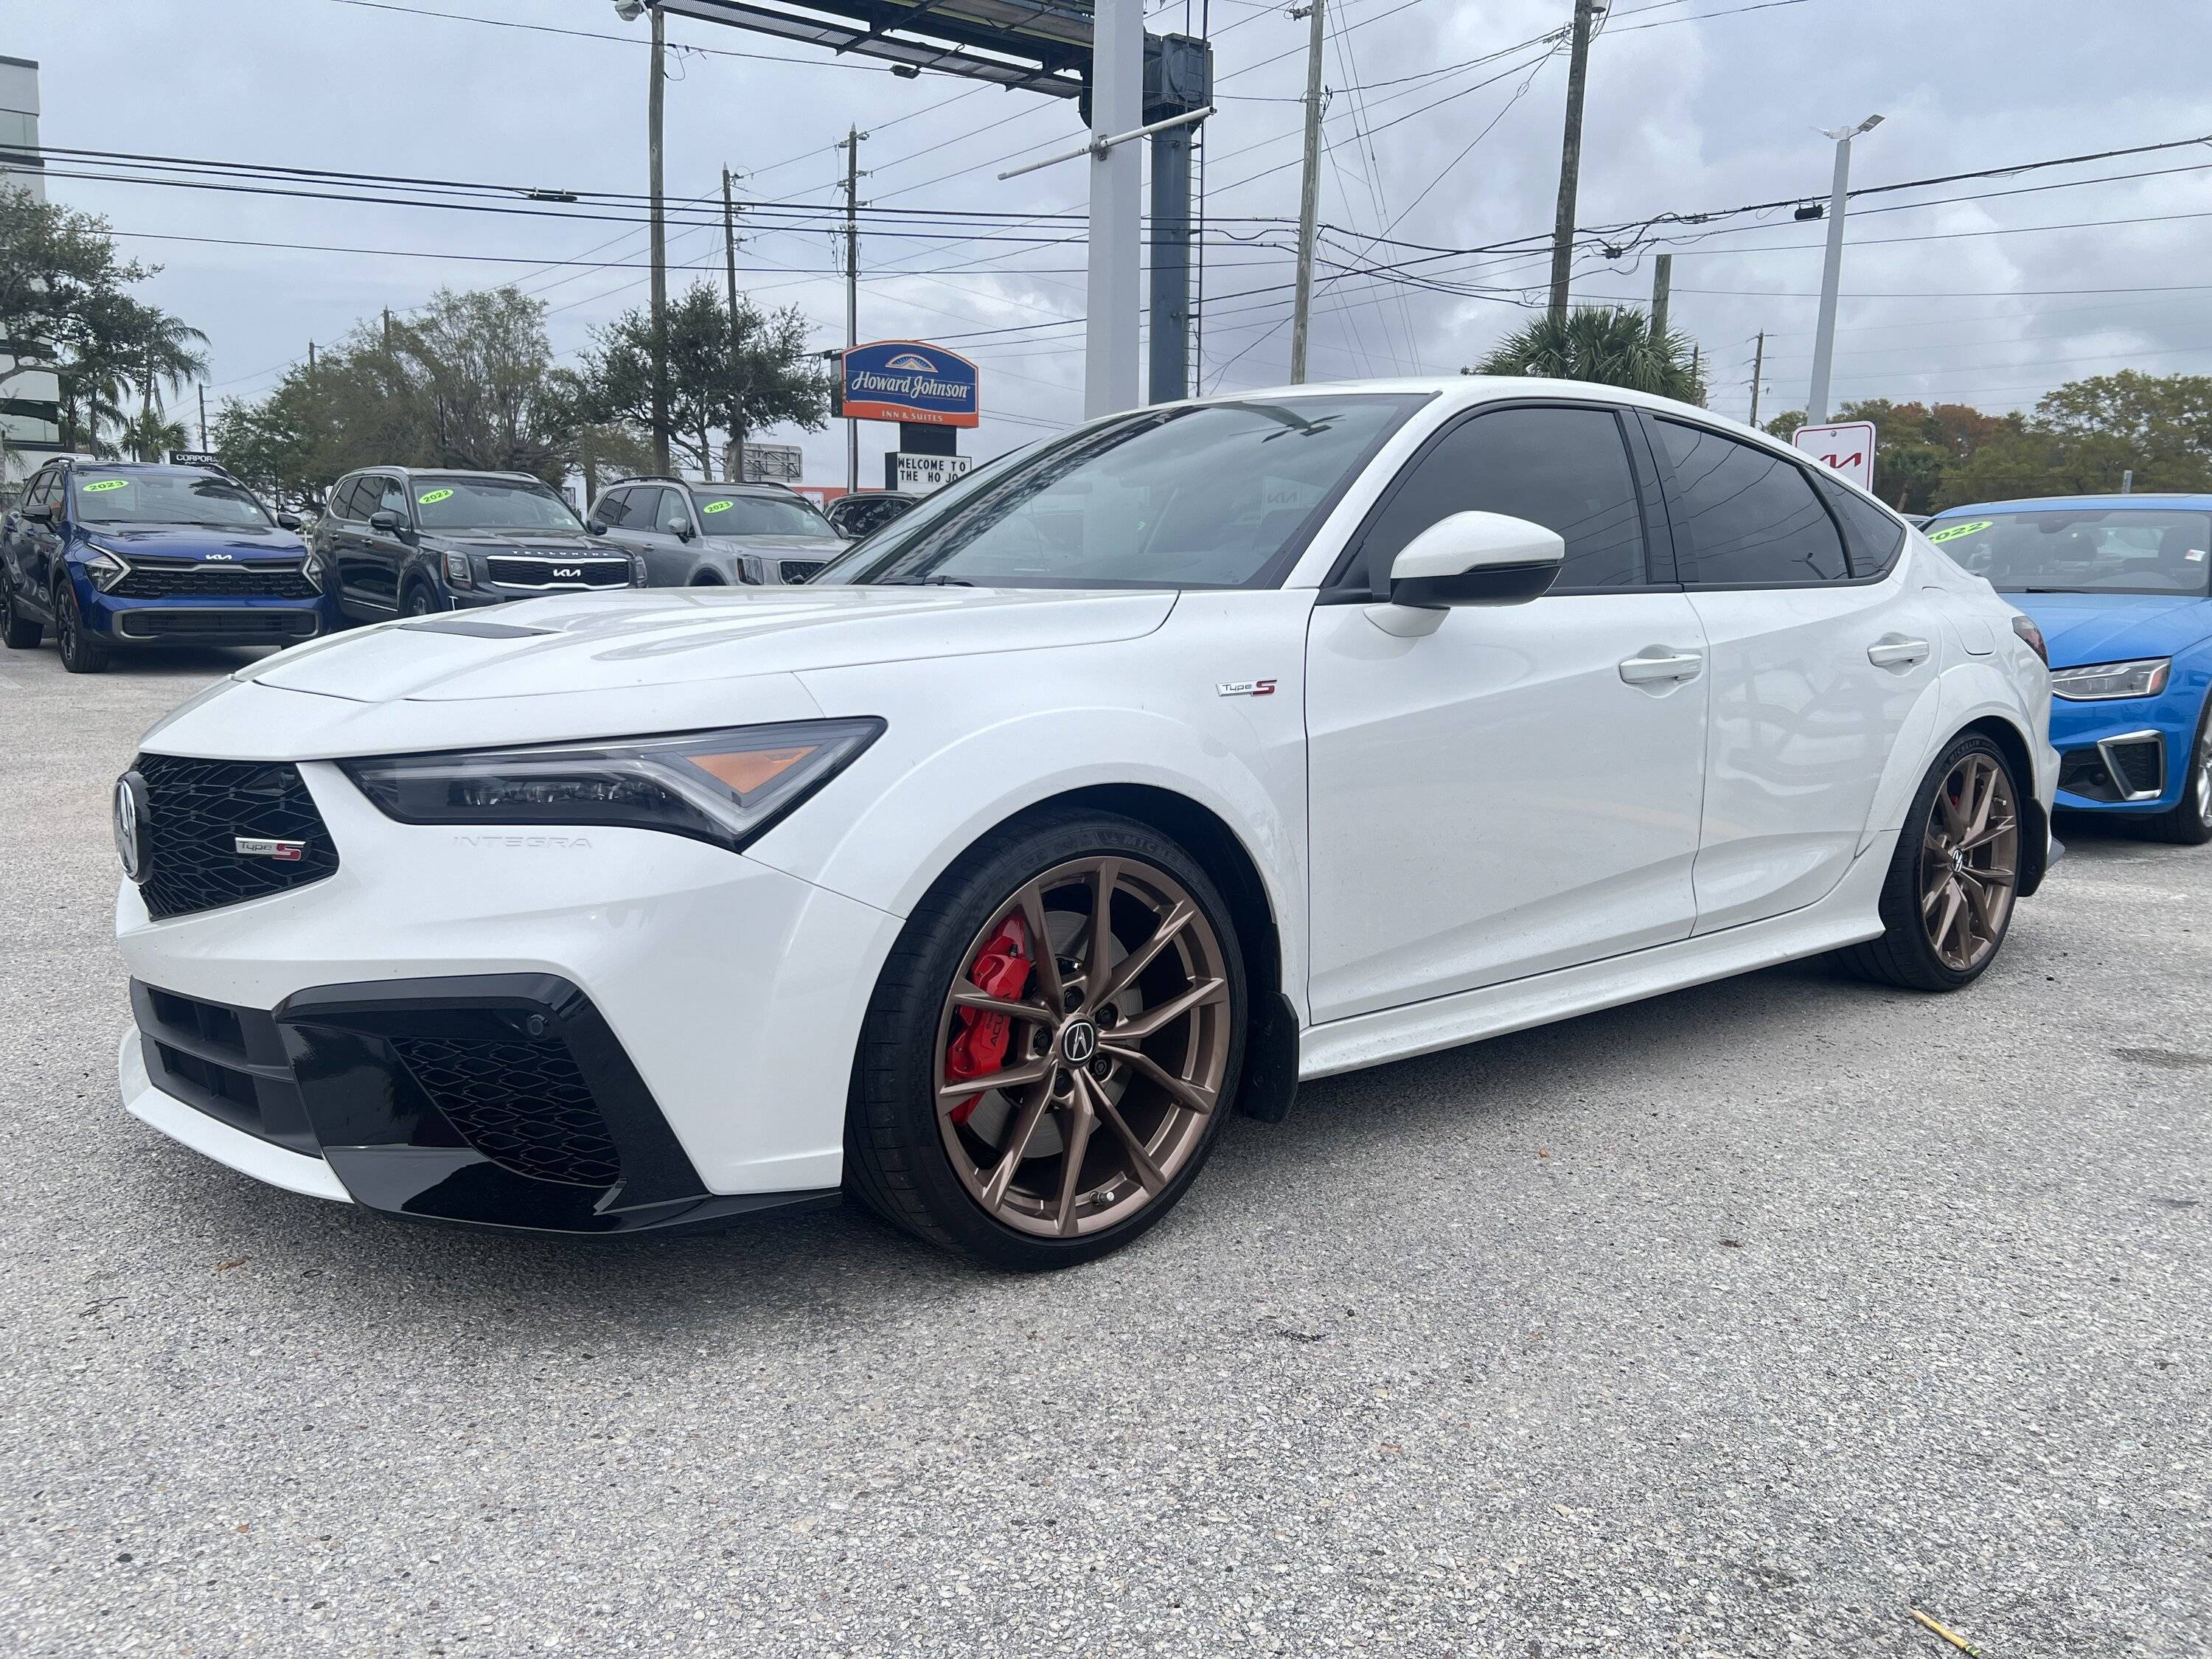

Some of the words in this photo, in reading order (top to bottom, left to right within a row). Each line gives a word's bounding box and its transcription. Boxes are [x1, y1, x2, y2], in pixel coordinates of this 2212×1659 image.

[852, 371, 911, 393] Howard
[911, 376, 967, 399] Johnson
[911, 412, 944, 422] SUITES
[898, 458, 945, 470] WELCOME
[951, 461, 966, 472] TO
[900, 470, 918, 481] THE
[928, 472, 941, 482] HO
[88, 481, 124, 490] 2023
[423, 490, 451, 502] 2022
[707, 501, 731, 512] 2023
[1929, 523, 1983, 540] 022
[553, 568, 581, 577] KIA
[1222, 684, 1252, 692] Type
[1253, 679, 1277, 695] S
[454, 836, 593, 848] INTEGRA
[239, 841, 272, 852] Type
[272, 843, 305, 861] S
